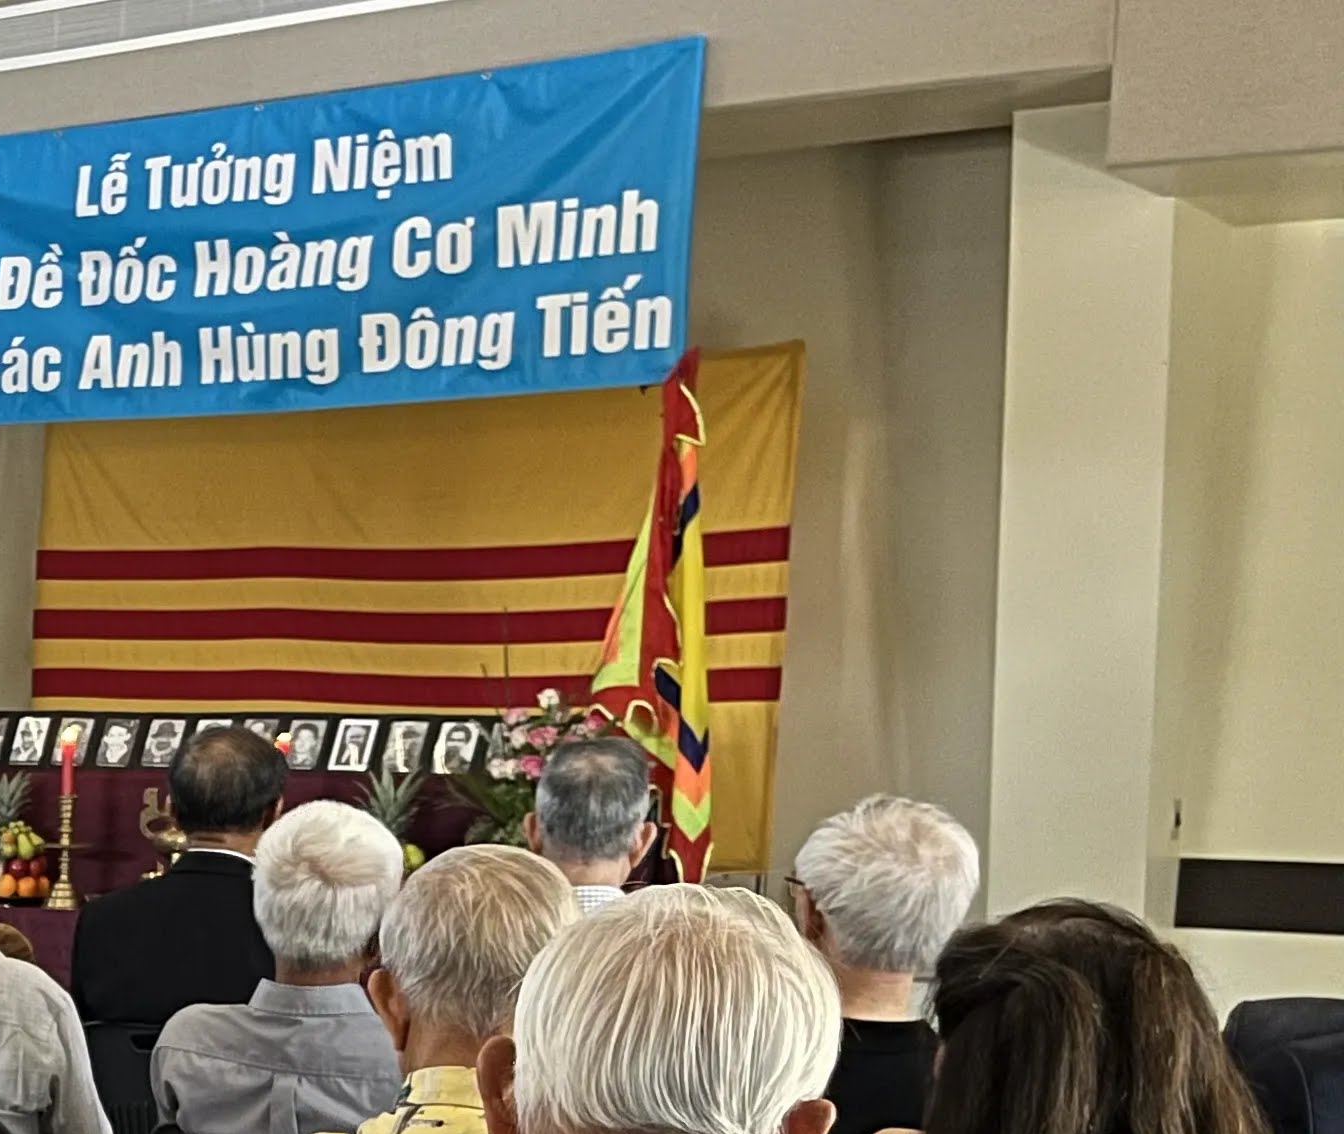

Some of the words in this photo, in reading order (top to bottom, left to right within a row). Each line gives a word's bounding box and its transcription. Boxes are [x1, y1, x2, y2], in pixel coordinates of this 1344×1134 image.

[75, 152, 132, 218] Lễ
[144, 142, 296, 210] Tưởng
[311, 129, 453, 200] Niệm
[77, 236, 177, 307] Đốc
[194, 231, 374, 299] Hoàng
[392, 215, 475, 279] Cơ
[497, 189, 659, 268] Minh
[78, 331, 183, 390] Anh
[198, 321, 339, 387] Hùng
[359, 307, 515, 374] Đông
[535, 273, 673, 359] Tiến
